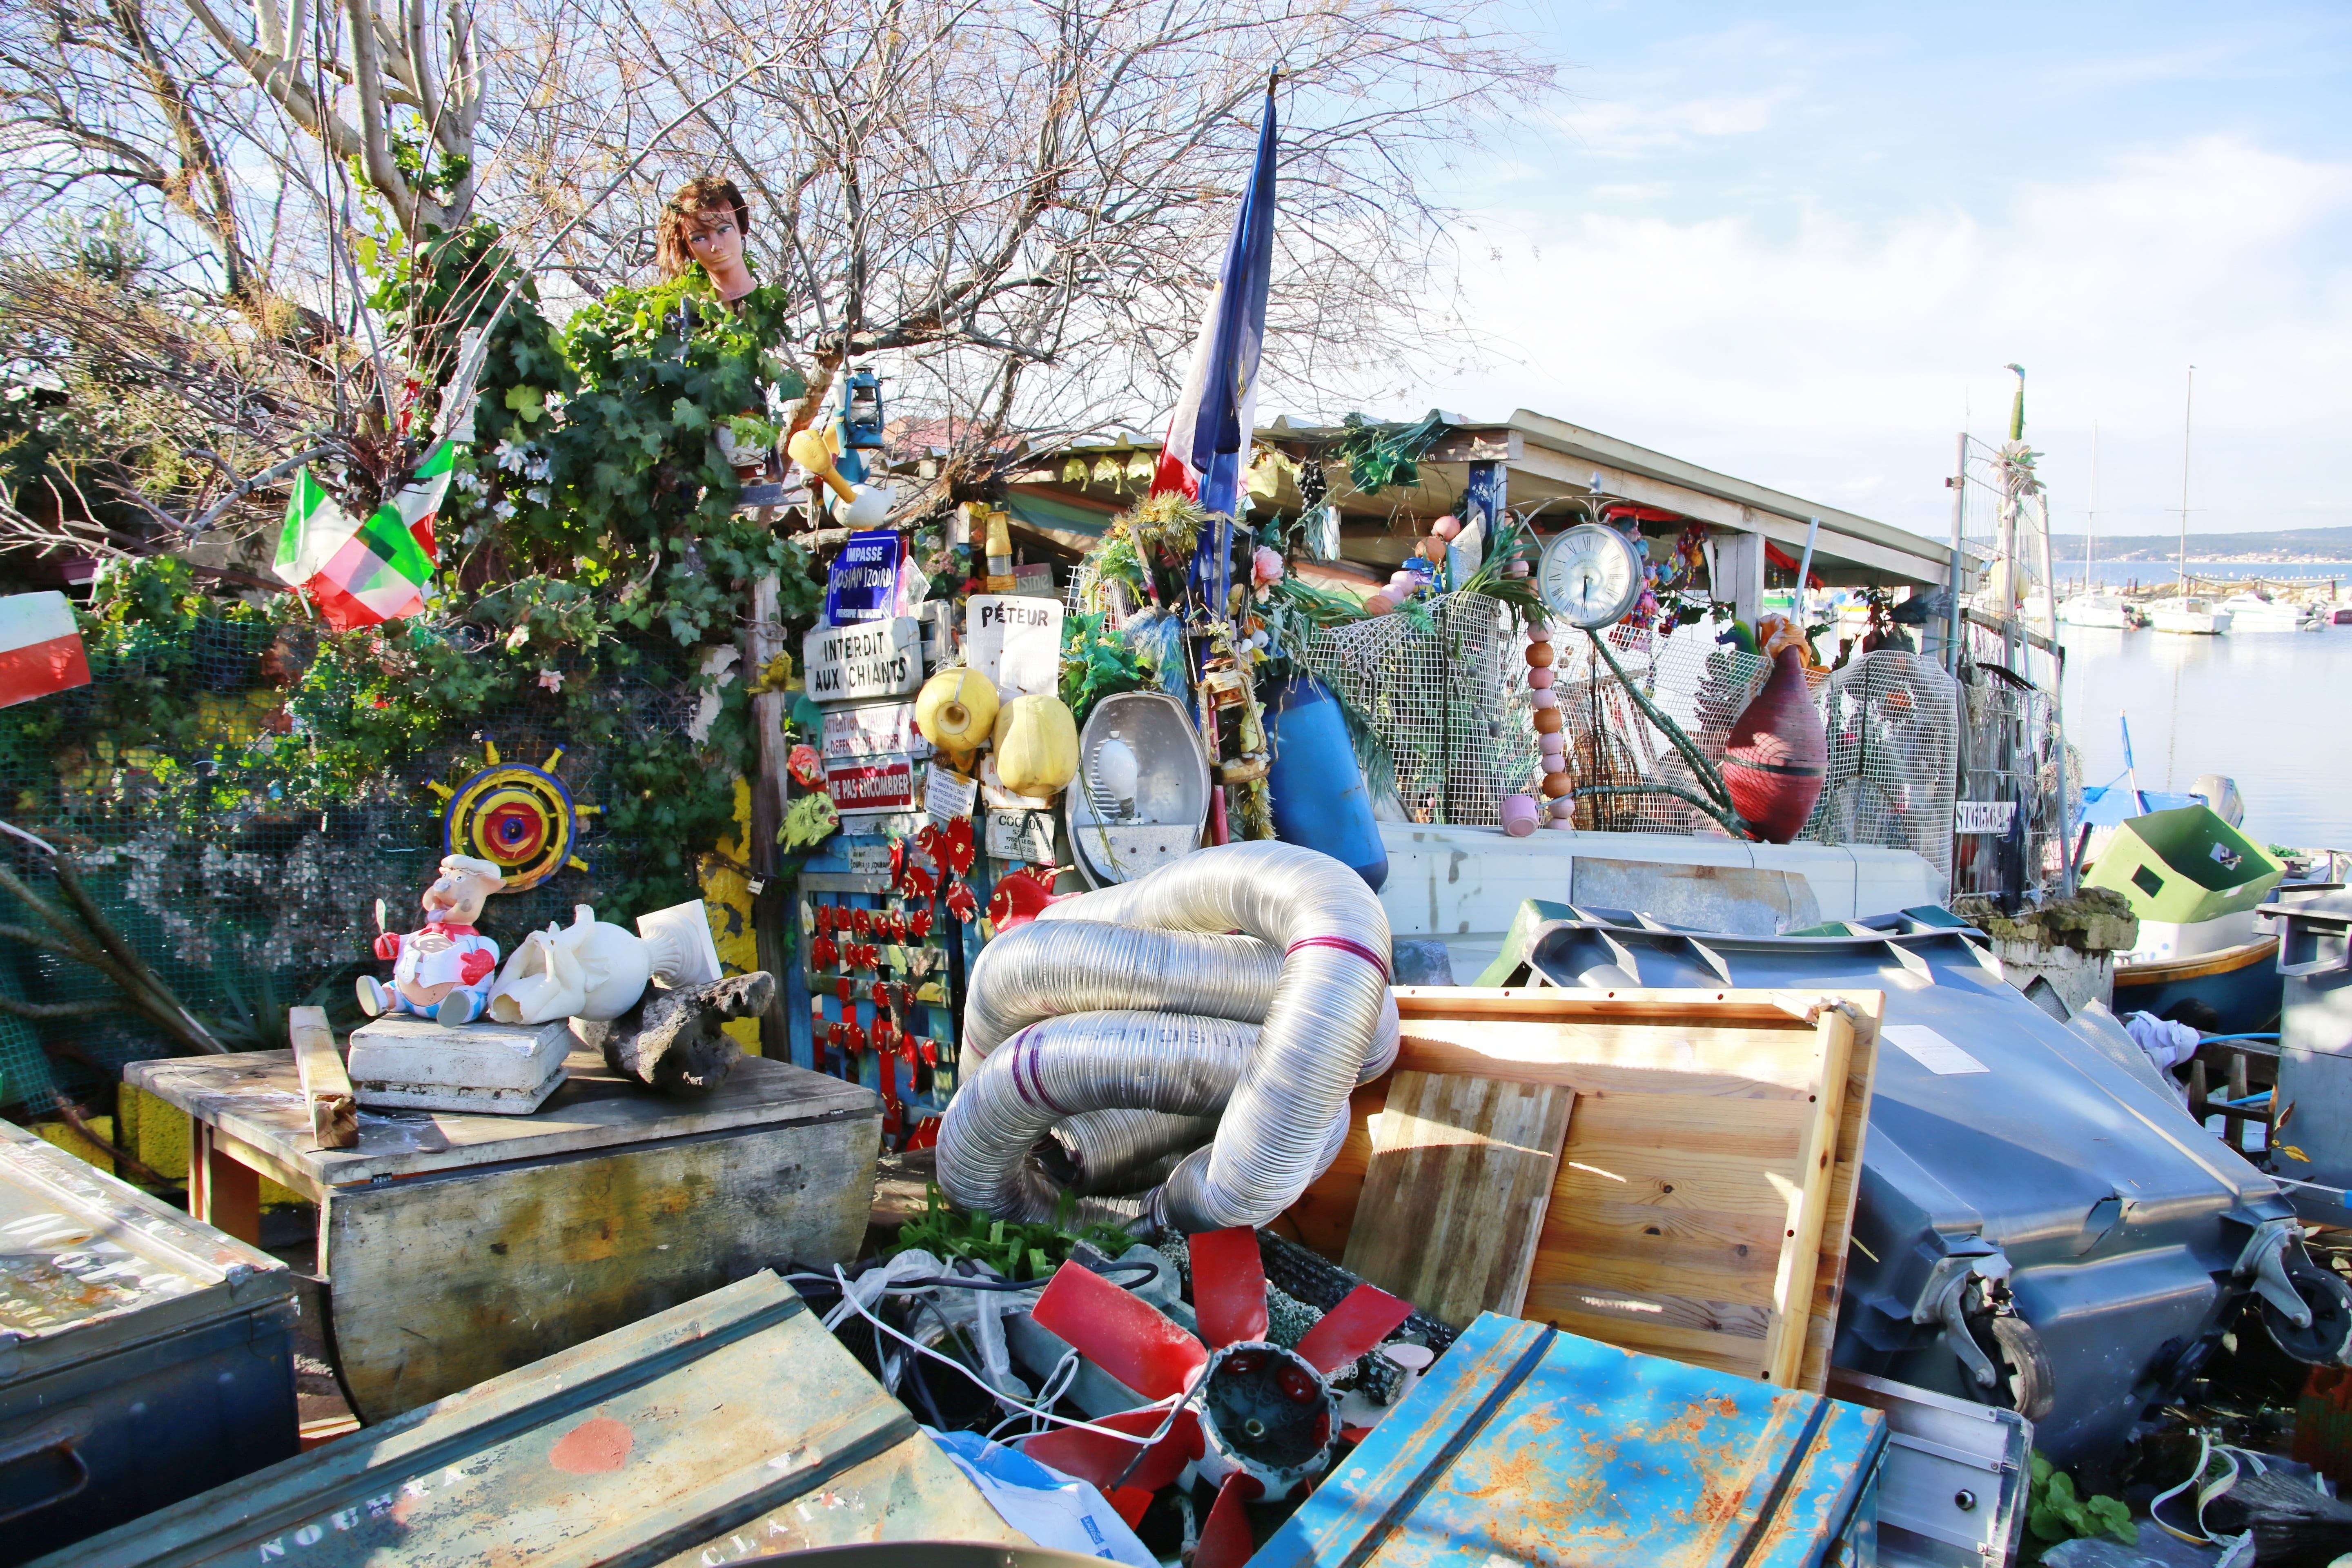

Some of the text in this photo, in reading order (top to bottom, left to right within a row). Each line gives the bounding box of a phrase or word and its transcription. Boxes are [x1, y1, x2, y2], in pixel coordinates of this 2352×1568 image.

[846, 546, 883, 562] IMPASSE
[981, 601, 1048, 628] PÉTEUR
[824, 632, 883, 662] INTERDIT
[815, 657, 906, 692] AUX CHIANTS
[824, 710, 907, 734] ATTENTION TAUREAUX
[830, 774, 910, 800] NE PAS ENCOMBRER
[942, 775, 959, 786] CONCESSION
